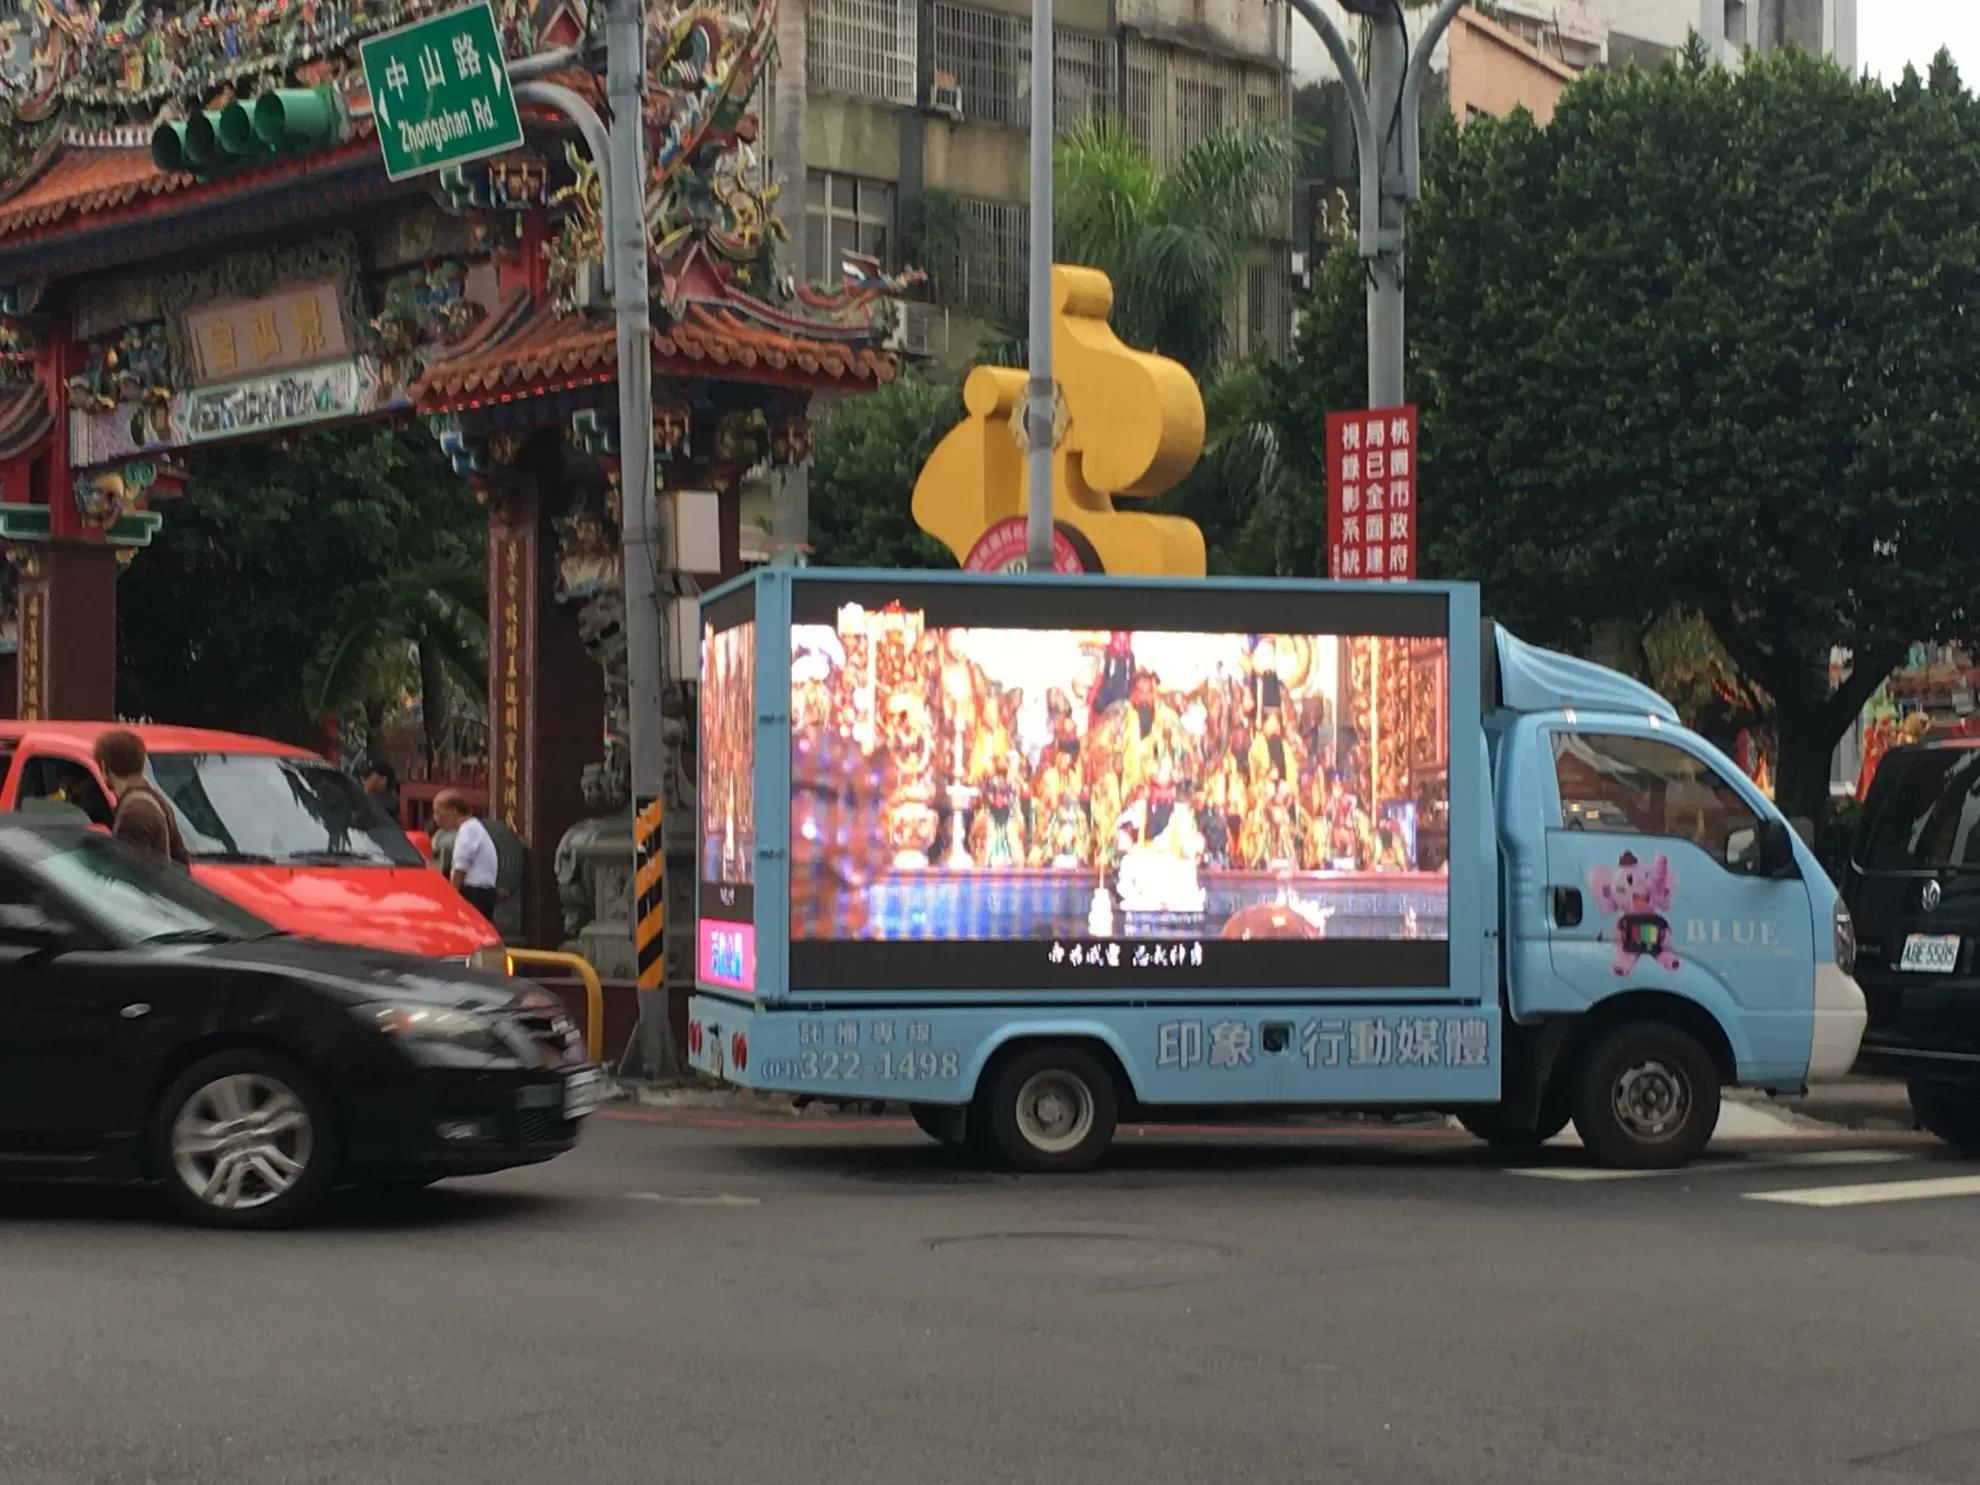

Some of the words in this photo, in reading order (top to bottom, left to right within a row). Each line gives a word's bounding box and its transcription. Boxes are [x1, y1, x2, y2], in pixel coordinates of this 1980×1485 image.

[385, 32, 482, 102] 中山路
[397, 108, 473, 152] Zhongshan
[470, 95, 498, 130] Rd.
[1365, 420, 1385, 583] 局已全面建
[1389, 417, 1410, 583] 桃園市政府
[1686, 917, 1781, 945] BLUE
[1156, 1019, 1254, 1070] 印象
[1301, 1017, 1490, 1070] 行動媒體
